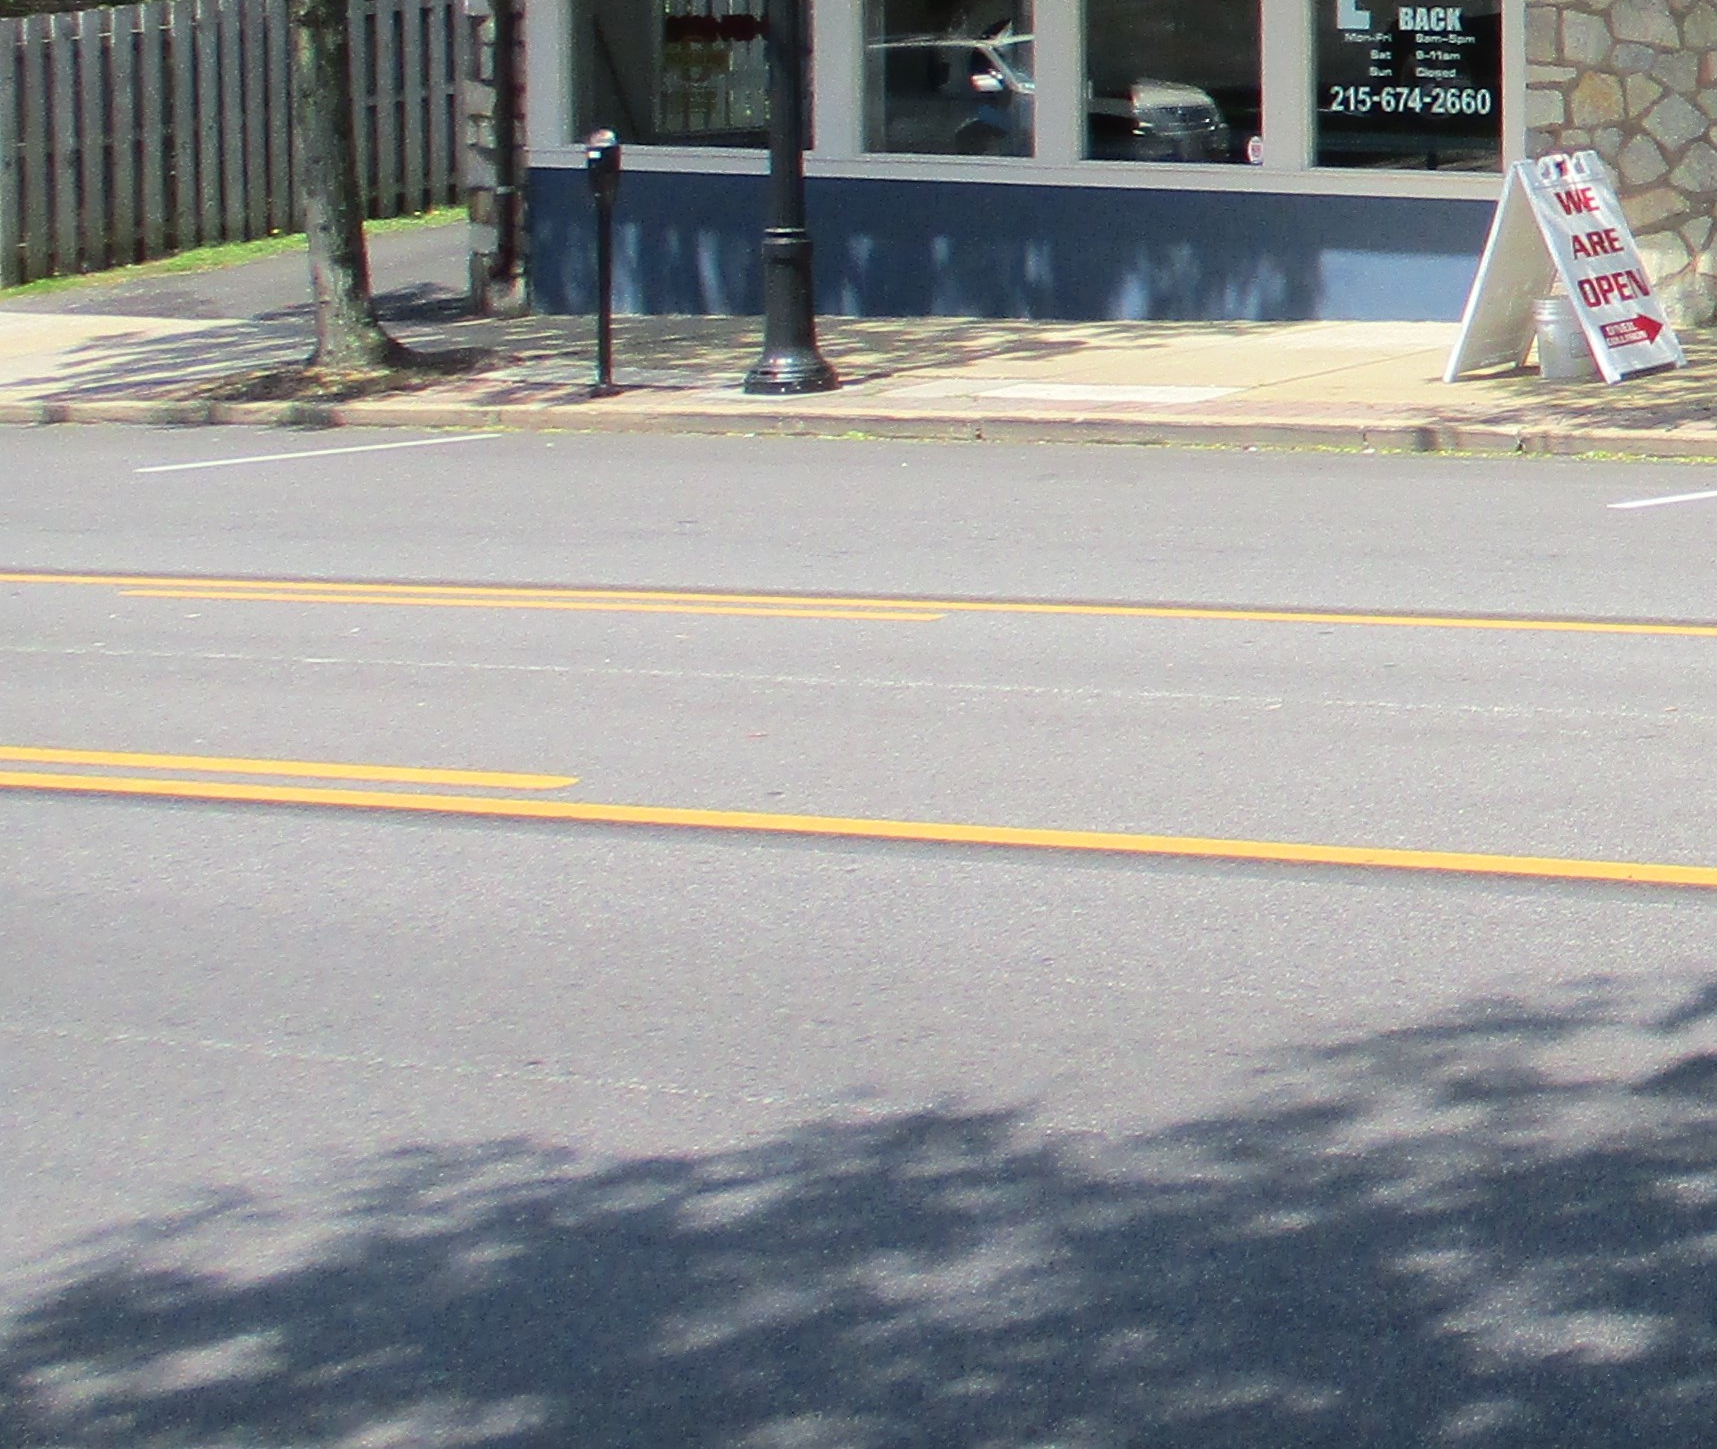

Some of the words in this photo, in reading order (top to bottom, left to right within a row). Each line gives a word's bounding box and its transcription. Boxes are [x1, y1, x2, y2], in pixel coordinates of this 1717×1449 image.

[1398, 7, 1463, 31] BACK
[1370, 49, 1392, 60] Sat
[1369, 66, 1392, 77] Sun
[1415, 67, 1456, 77] Closed
[1330, 86, 1491, 115] 215-674-2660
[1553, 187, 1600, 215] WE
[1572, 228, 1625, 260] ARE
[1578, 270, 1650, 307] OPEN
